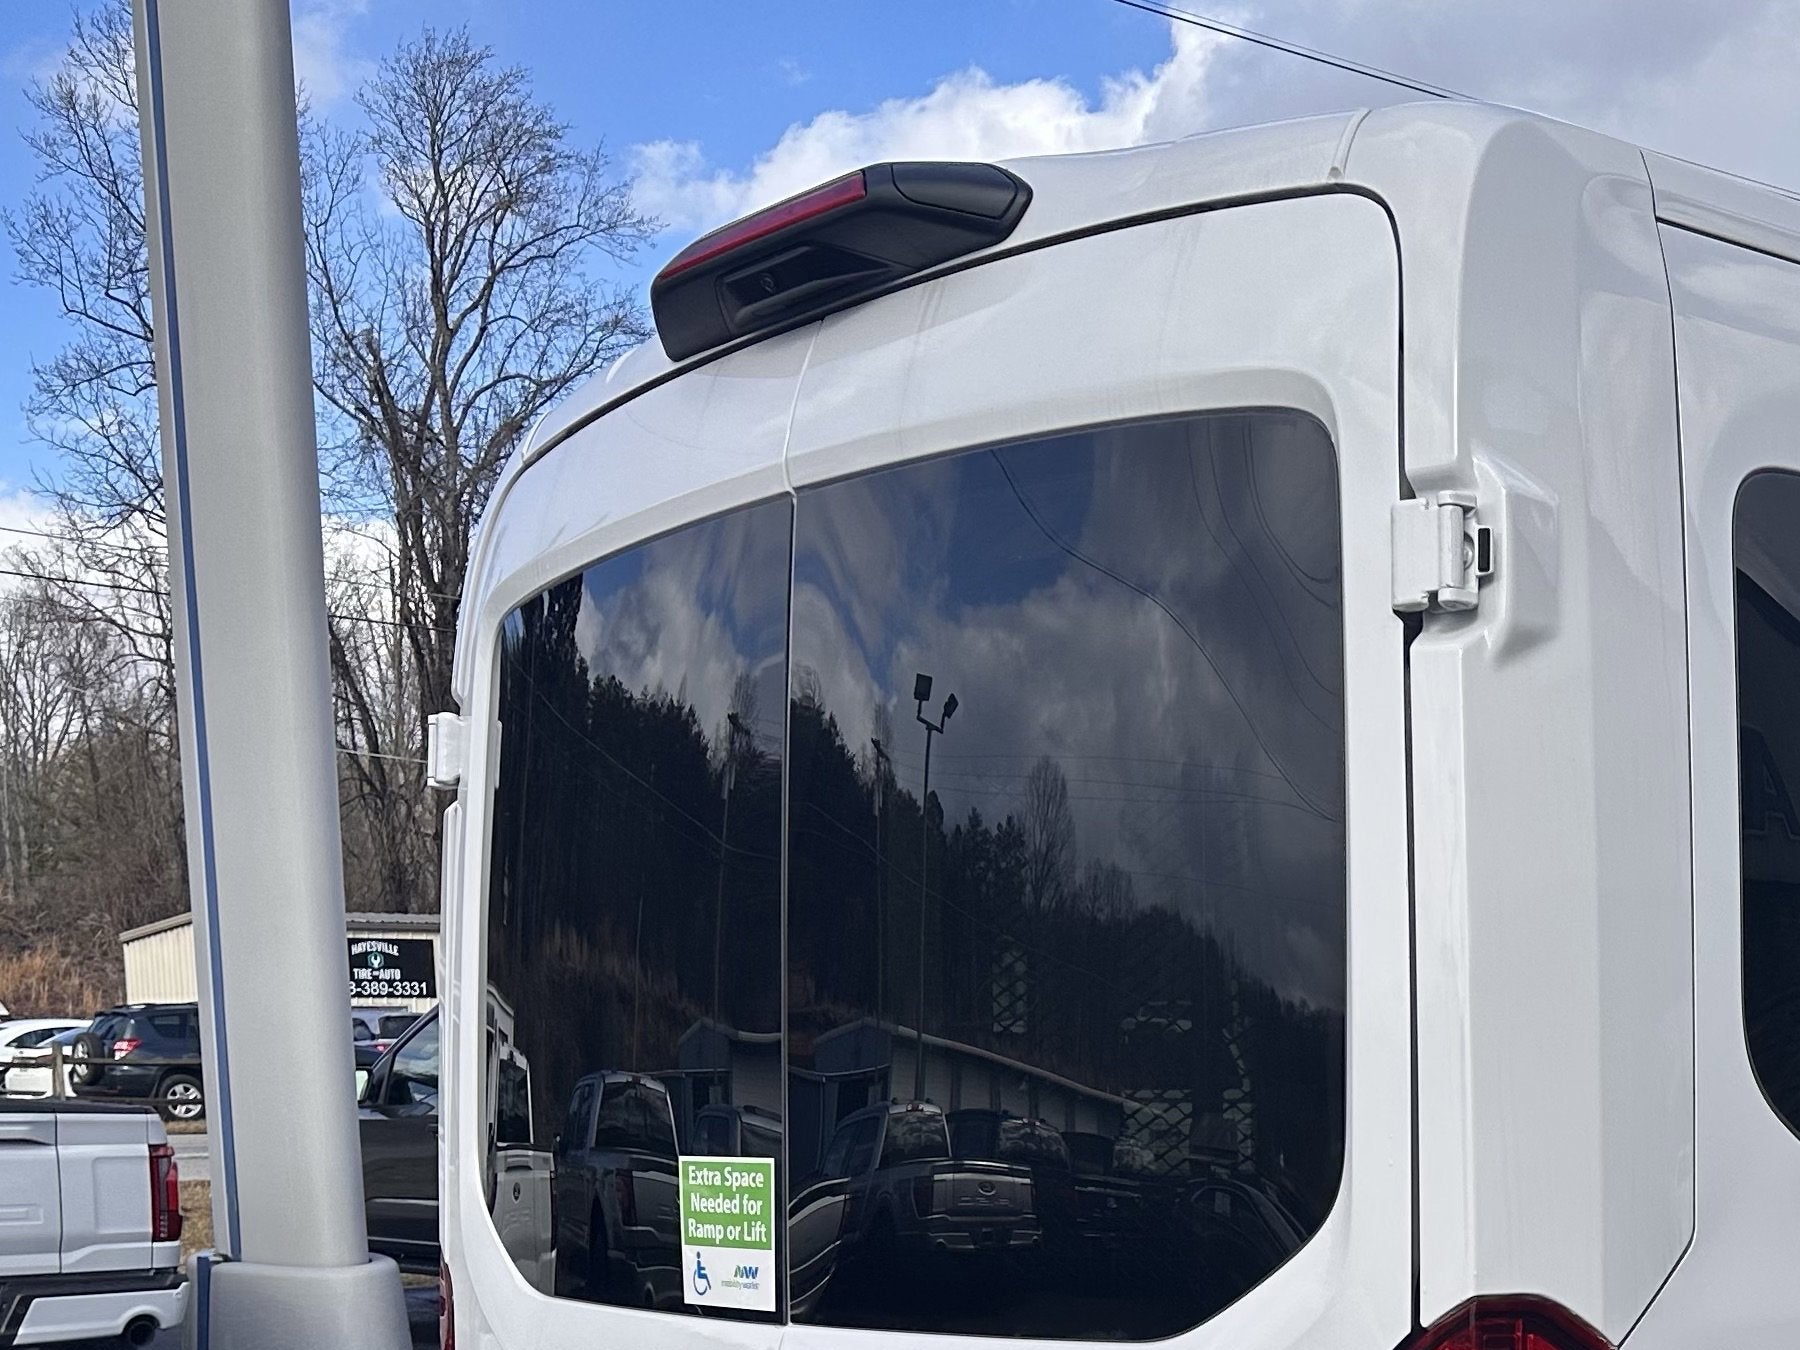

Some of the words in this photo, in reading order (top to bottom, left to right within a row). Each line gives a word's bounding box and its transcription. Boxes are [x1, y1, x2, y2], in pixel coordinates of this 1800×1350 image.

[350, 940, 400, 957] HAYESVILLE
[352, 967, 373, 980] TIRE
[379, 968, 401, 980] AUTO
[688, 1165, 722, 1186] Extra
[724, 1166, 764, 1191] Space
[690, 1192, 740, 1214] Needed
[742, 1193, 763, 1216] for
[688, 1218, 725, 1244] Ramp
[726, 1224, 742, 1241] or
[743, 1220, 767, 1243] Lift
